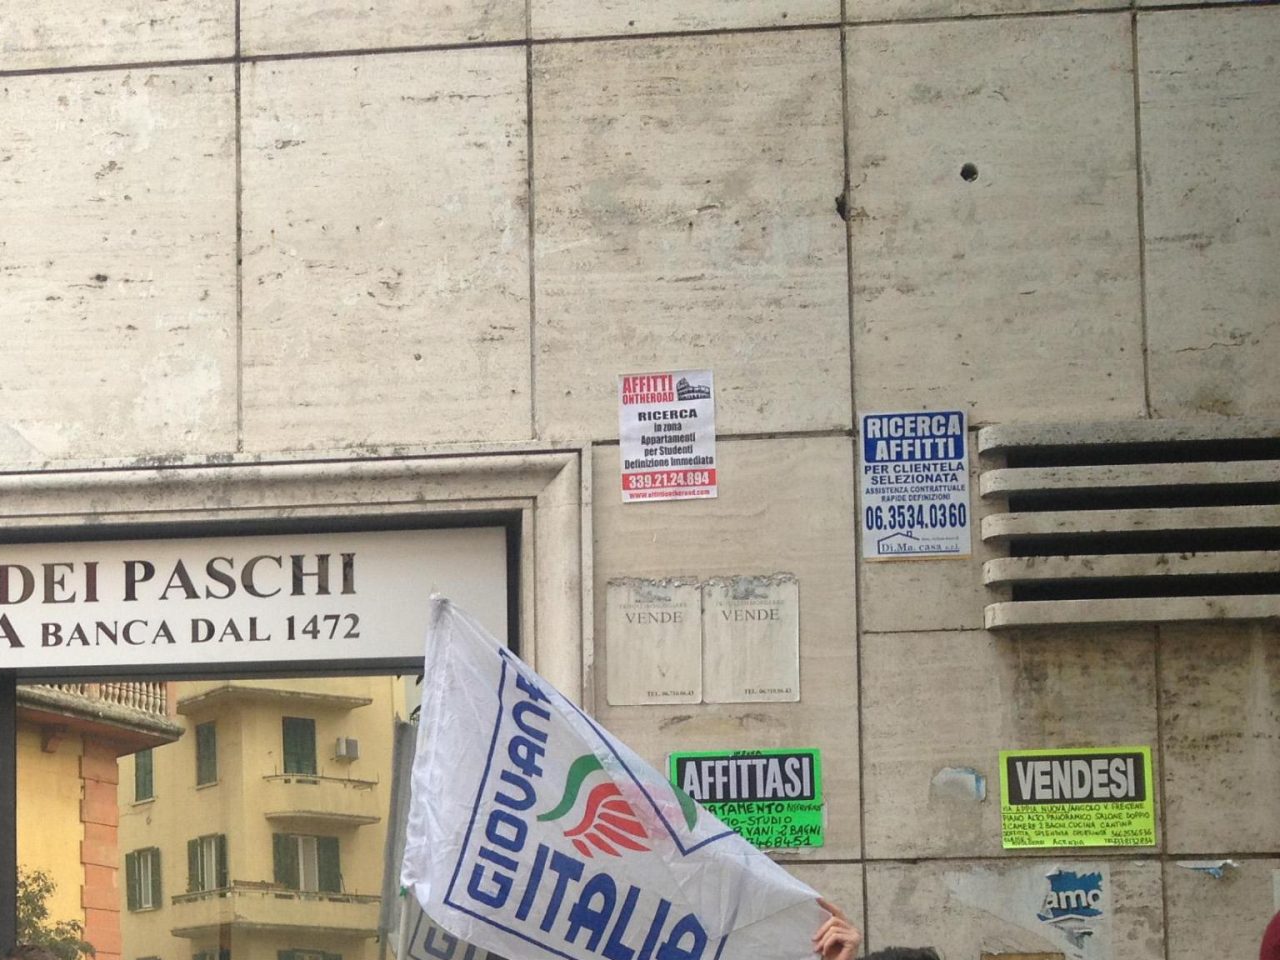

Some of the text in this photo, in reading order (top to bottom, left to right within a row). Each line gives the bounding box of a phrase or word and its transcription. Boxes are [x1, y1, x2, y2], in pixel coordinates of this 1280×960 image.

[622, 374, 673, 393] AFFITTI
[637, 408, 698, 421] RICERCA
[663, 422, 682, 432] zona
[866, 414, 961, 439] RICERCA
[641, 432, 696, 446] Appartamenti
[644, 445, 693, 457] per Studenti
[875, 437, 955, 460] AFFITTI
[624, 459, 669, 469] Definizione
[864, 462, 965, 475] PER CLIENTELA
[629, 471, 710, 488] 339.21.24.894
[871, 473, 958, 485] SELEZIONATA
[865, 484, 966, 495] ASSISTENZA CONTRATTUALE
[908, 493, 951, 502] DEFINIZIONI
[866, 502, 967, 530] 06.3534.0360
[123, 552, 357, 601] PASCHI
[625, 612, 683, 624] VENDE
[722, 609, 781, 622] VENDE
[41, 619, 176, 647] BANCA
[191, 617, 271, 643] DAL
[286, 613, 360, 640] 1472
[683, 757, 811, 799] AFFITTASI
[1016, 758, 1136, 800] VENDESI
[746, 825, 774, 836] VANI
[789, 824, 821, 836] BAGNI
